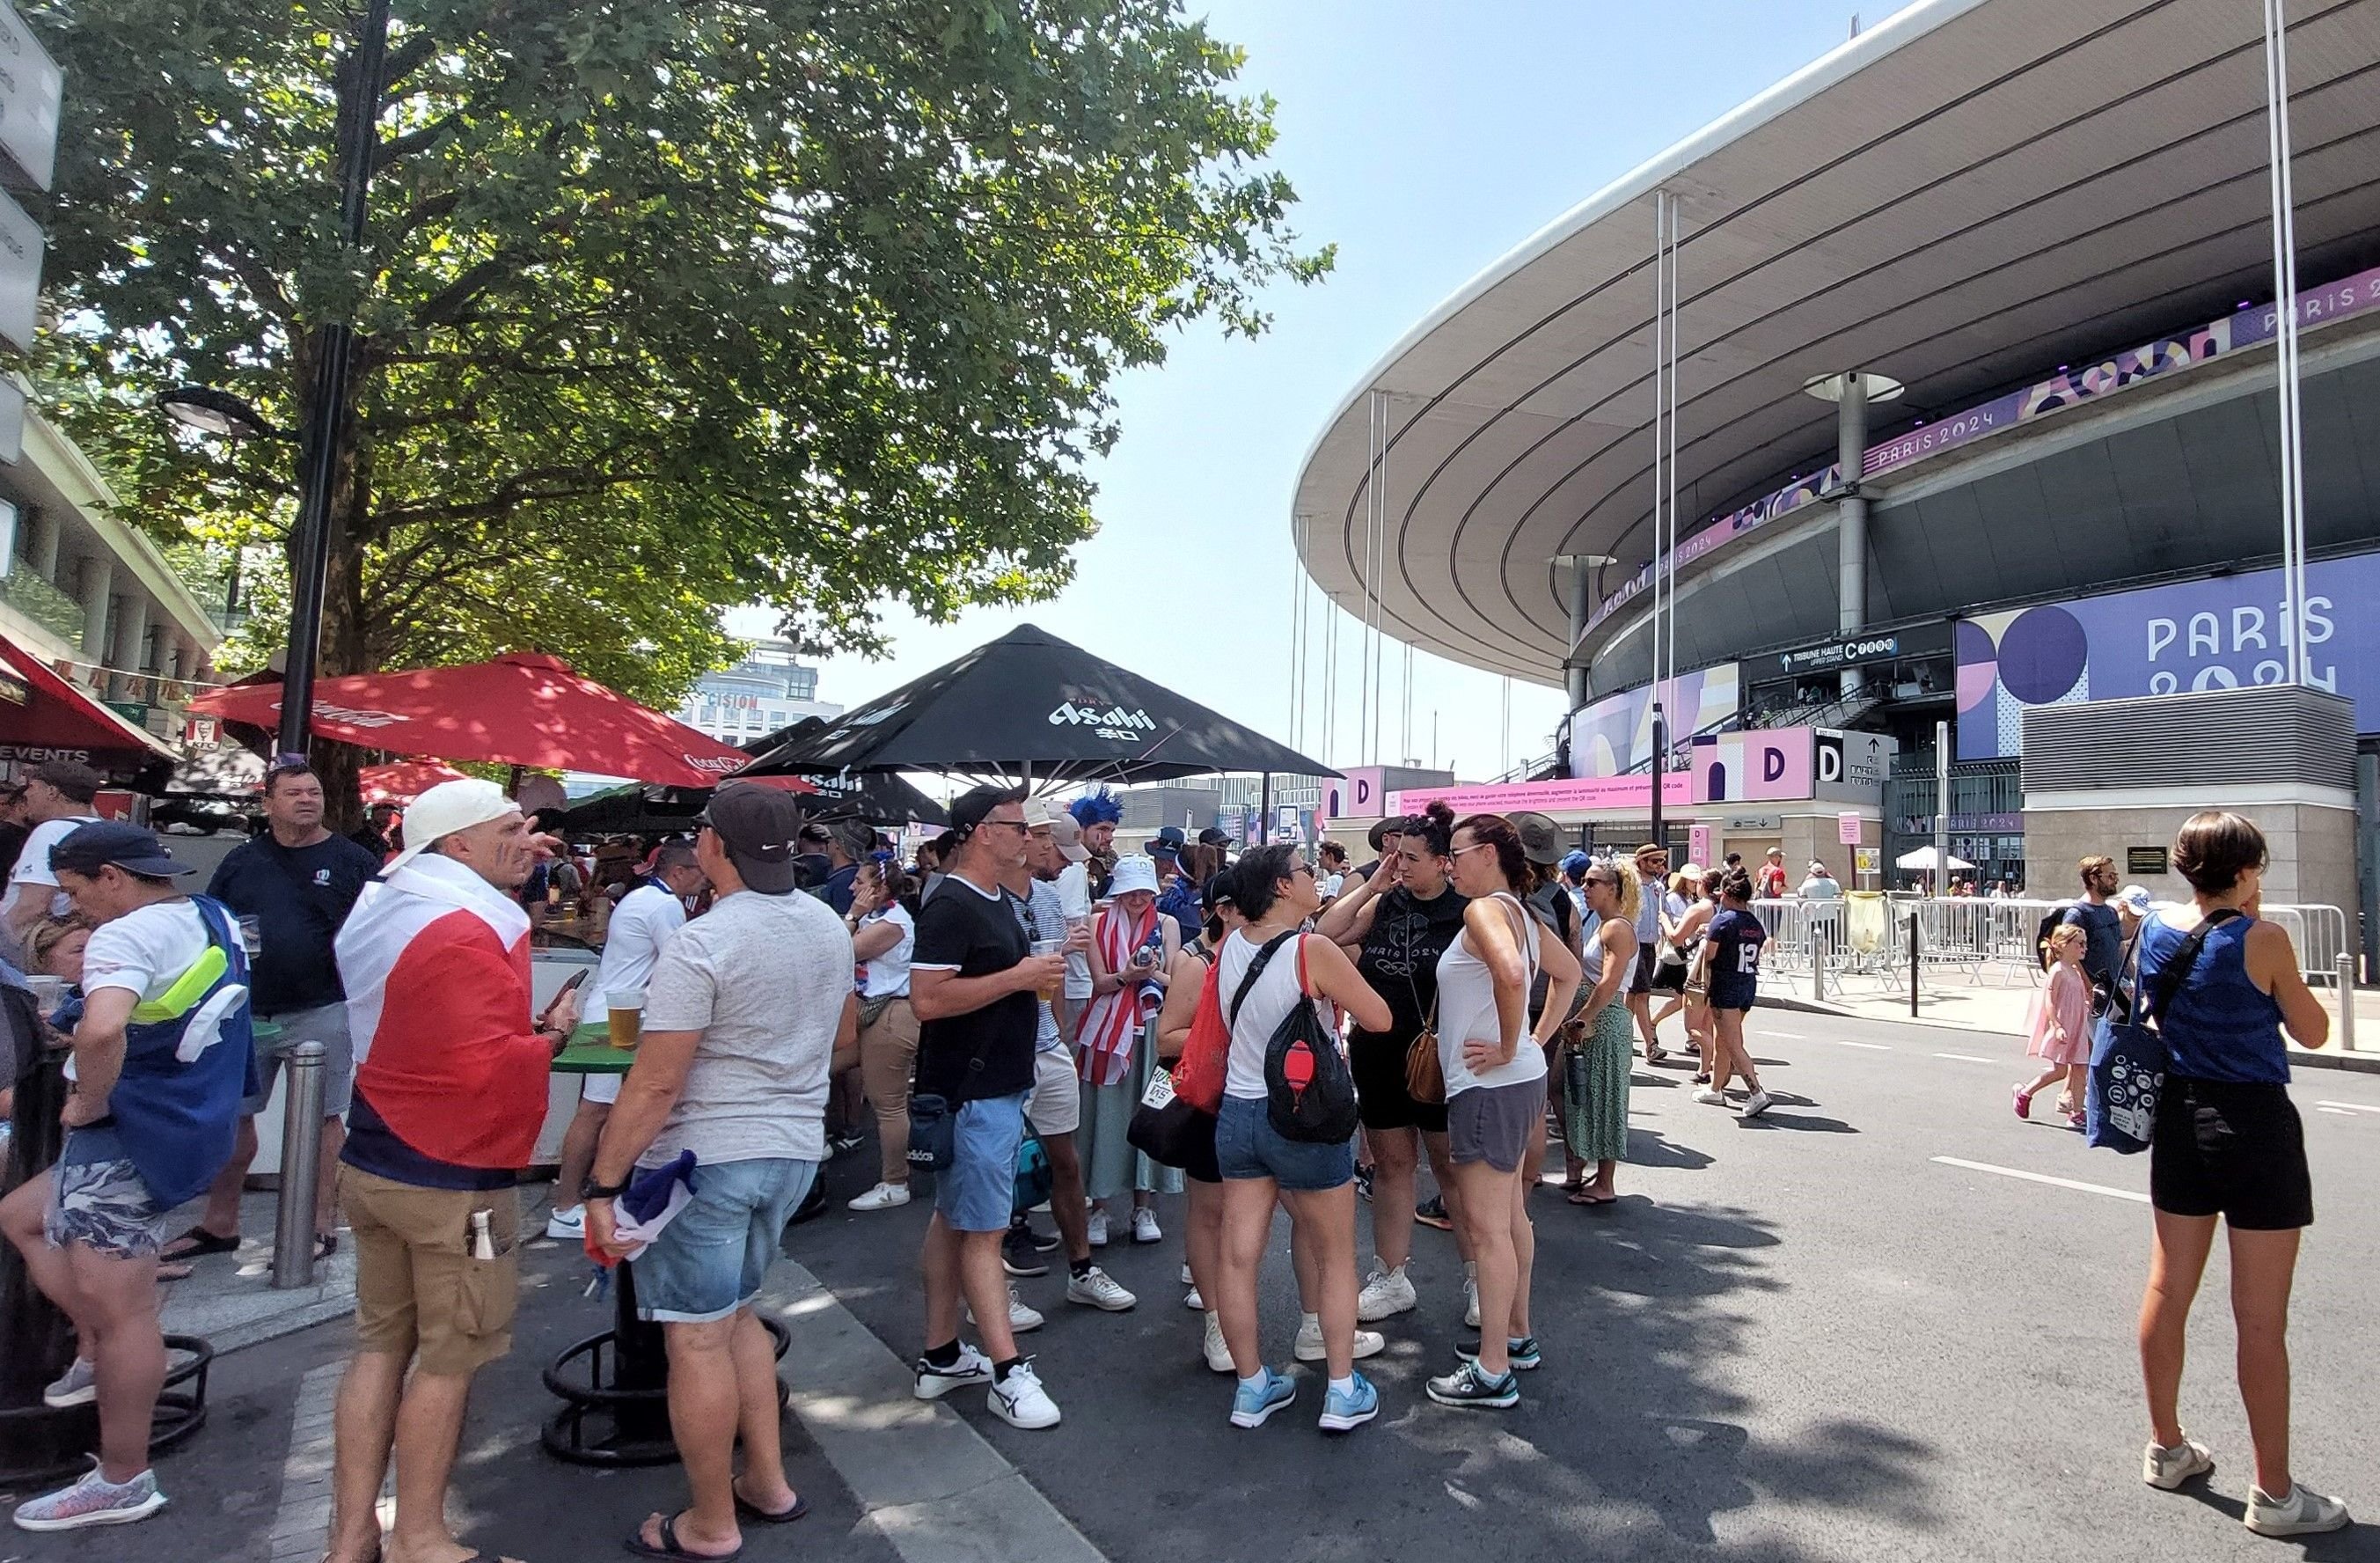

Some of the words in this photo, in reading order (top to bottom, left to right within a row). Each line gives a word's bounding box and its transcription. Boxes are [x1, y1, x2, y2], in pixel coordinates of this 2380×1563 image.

[1878, 434, 1931, 466] PARIS
[1939, 412, 1993, 444] 2024
[1660, 551, 1683, 573] PAIS
[2148, 596, 2334, 662] PARIS
[1793, 649, 1820, 663] TRIBUNE
[1821, 645, 1843, 657] HAUTE
[1845, 642, 1856, 659] C
[1827, 654, 1843, 663] STAND
[1048, 701, 1157, 730] Asahi
[0, 745, 90, 763] EVENTS
[1764, 747, 1785, 782] D
[1820, 745, 1841, 782] D
[1358, 779, 1369, 804] D
[1950, 818, 1978, 830] ARIS
[1737, 943, 1759, 974] 12
